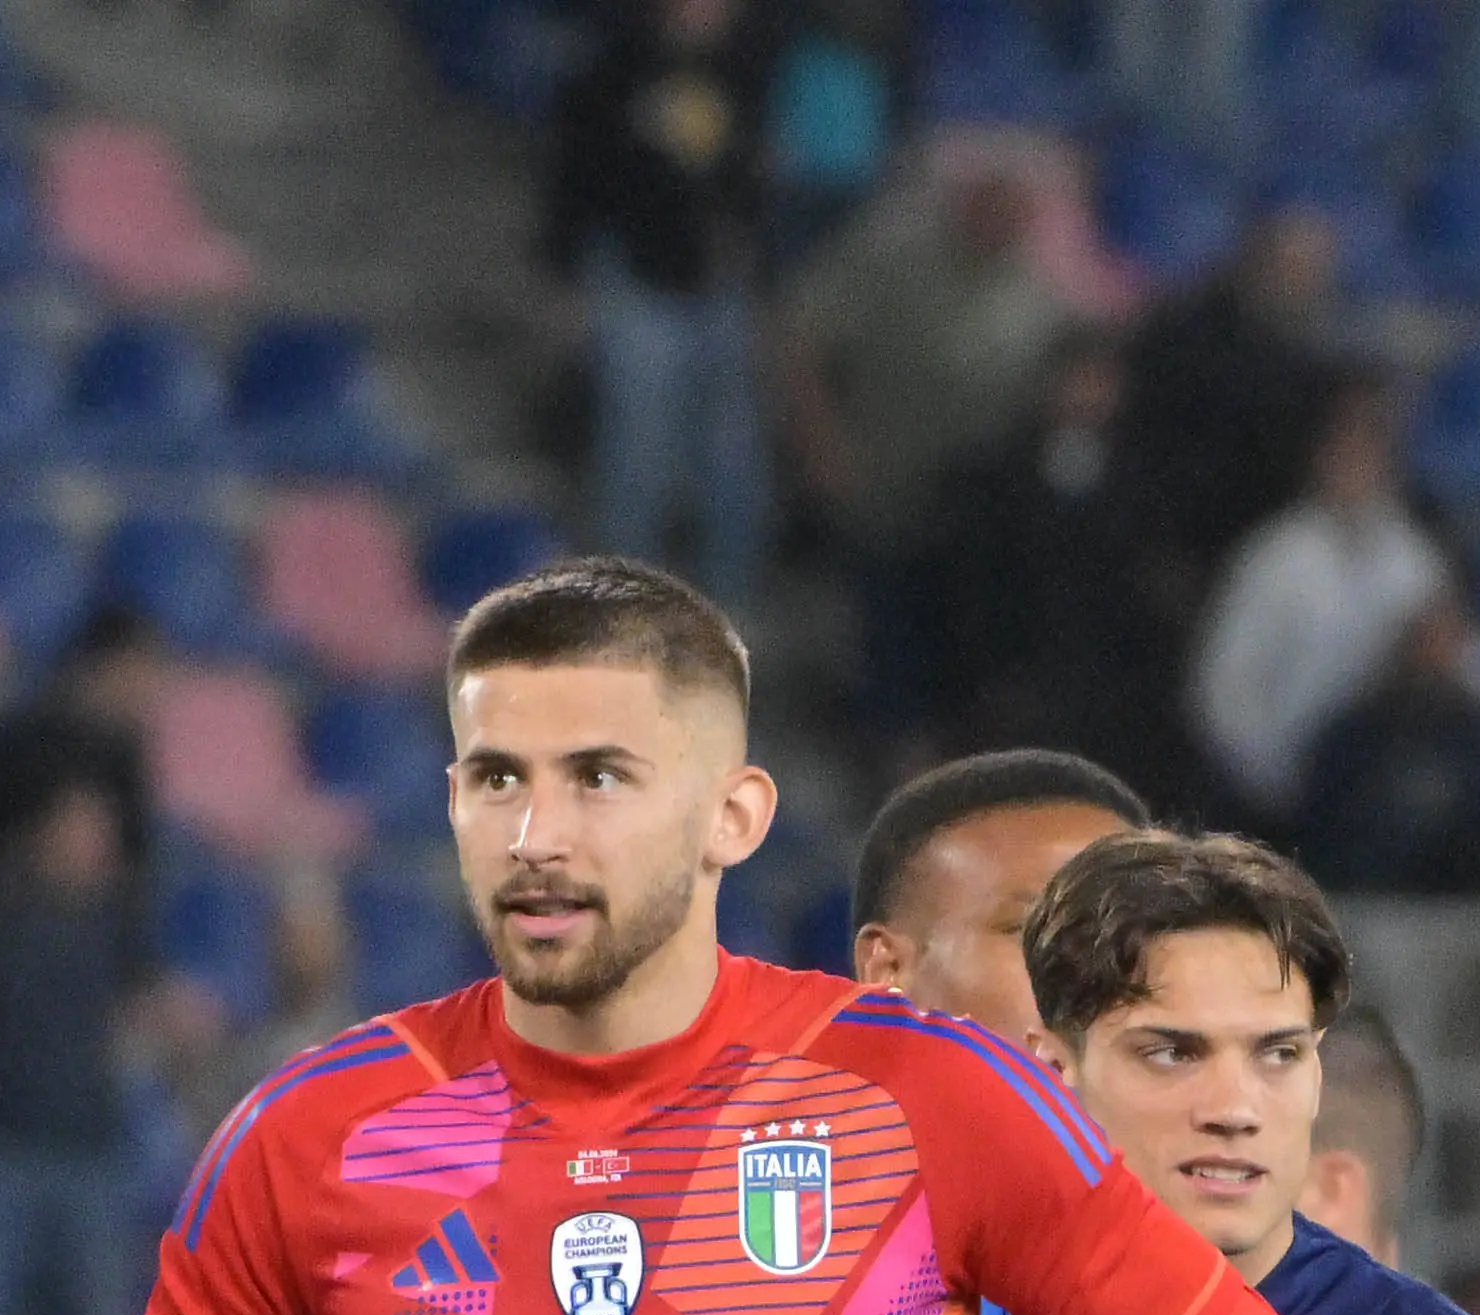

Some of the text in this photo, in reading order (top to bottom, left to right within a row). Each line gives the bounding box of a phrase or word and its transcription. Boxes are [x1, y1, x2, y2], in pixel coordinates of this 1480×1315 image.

[745, 1152, 823, 1178] ITALIA
[563, 1233, 628, 1249] EUROPEAN
[564, 1245, 628, 1260] CHAMPIONS
